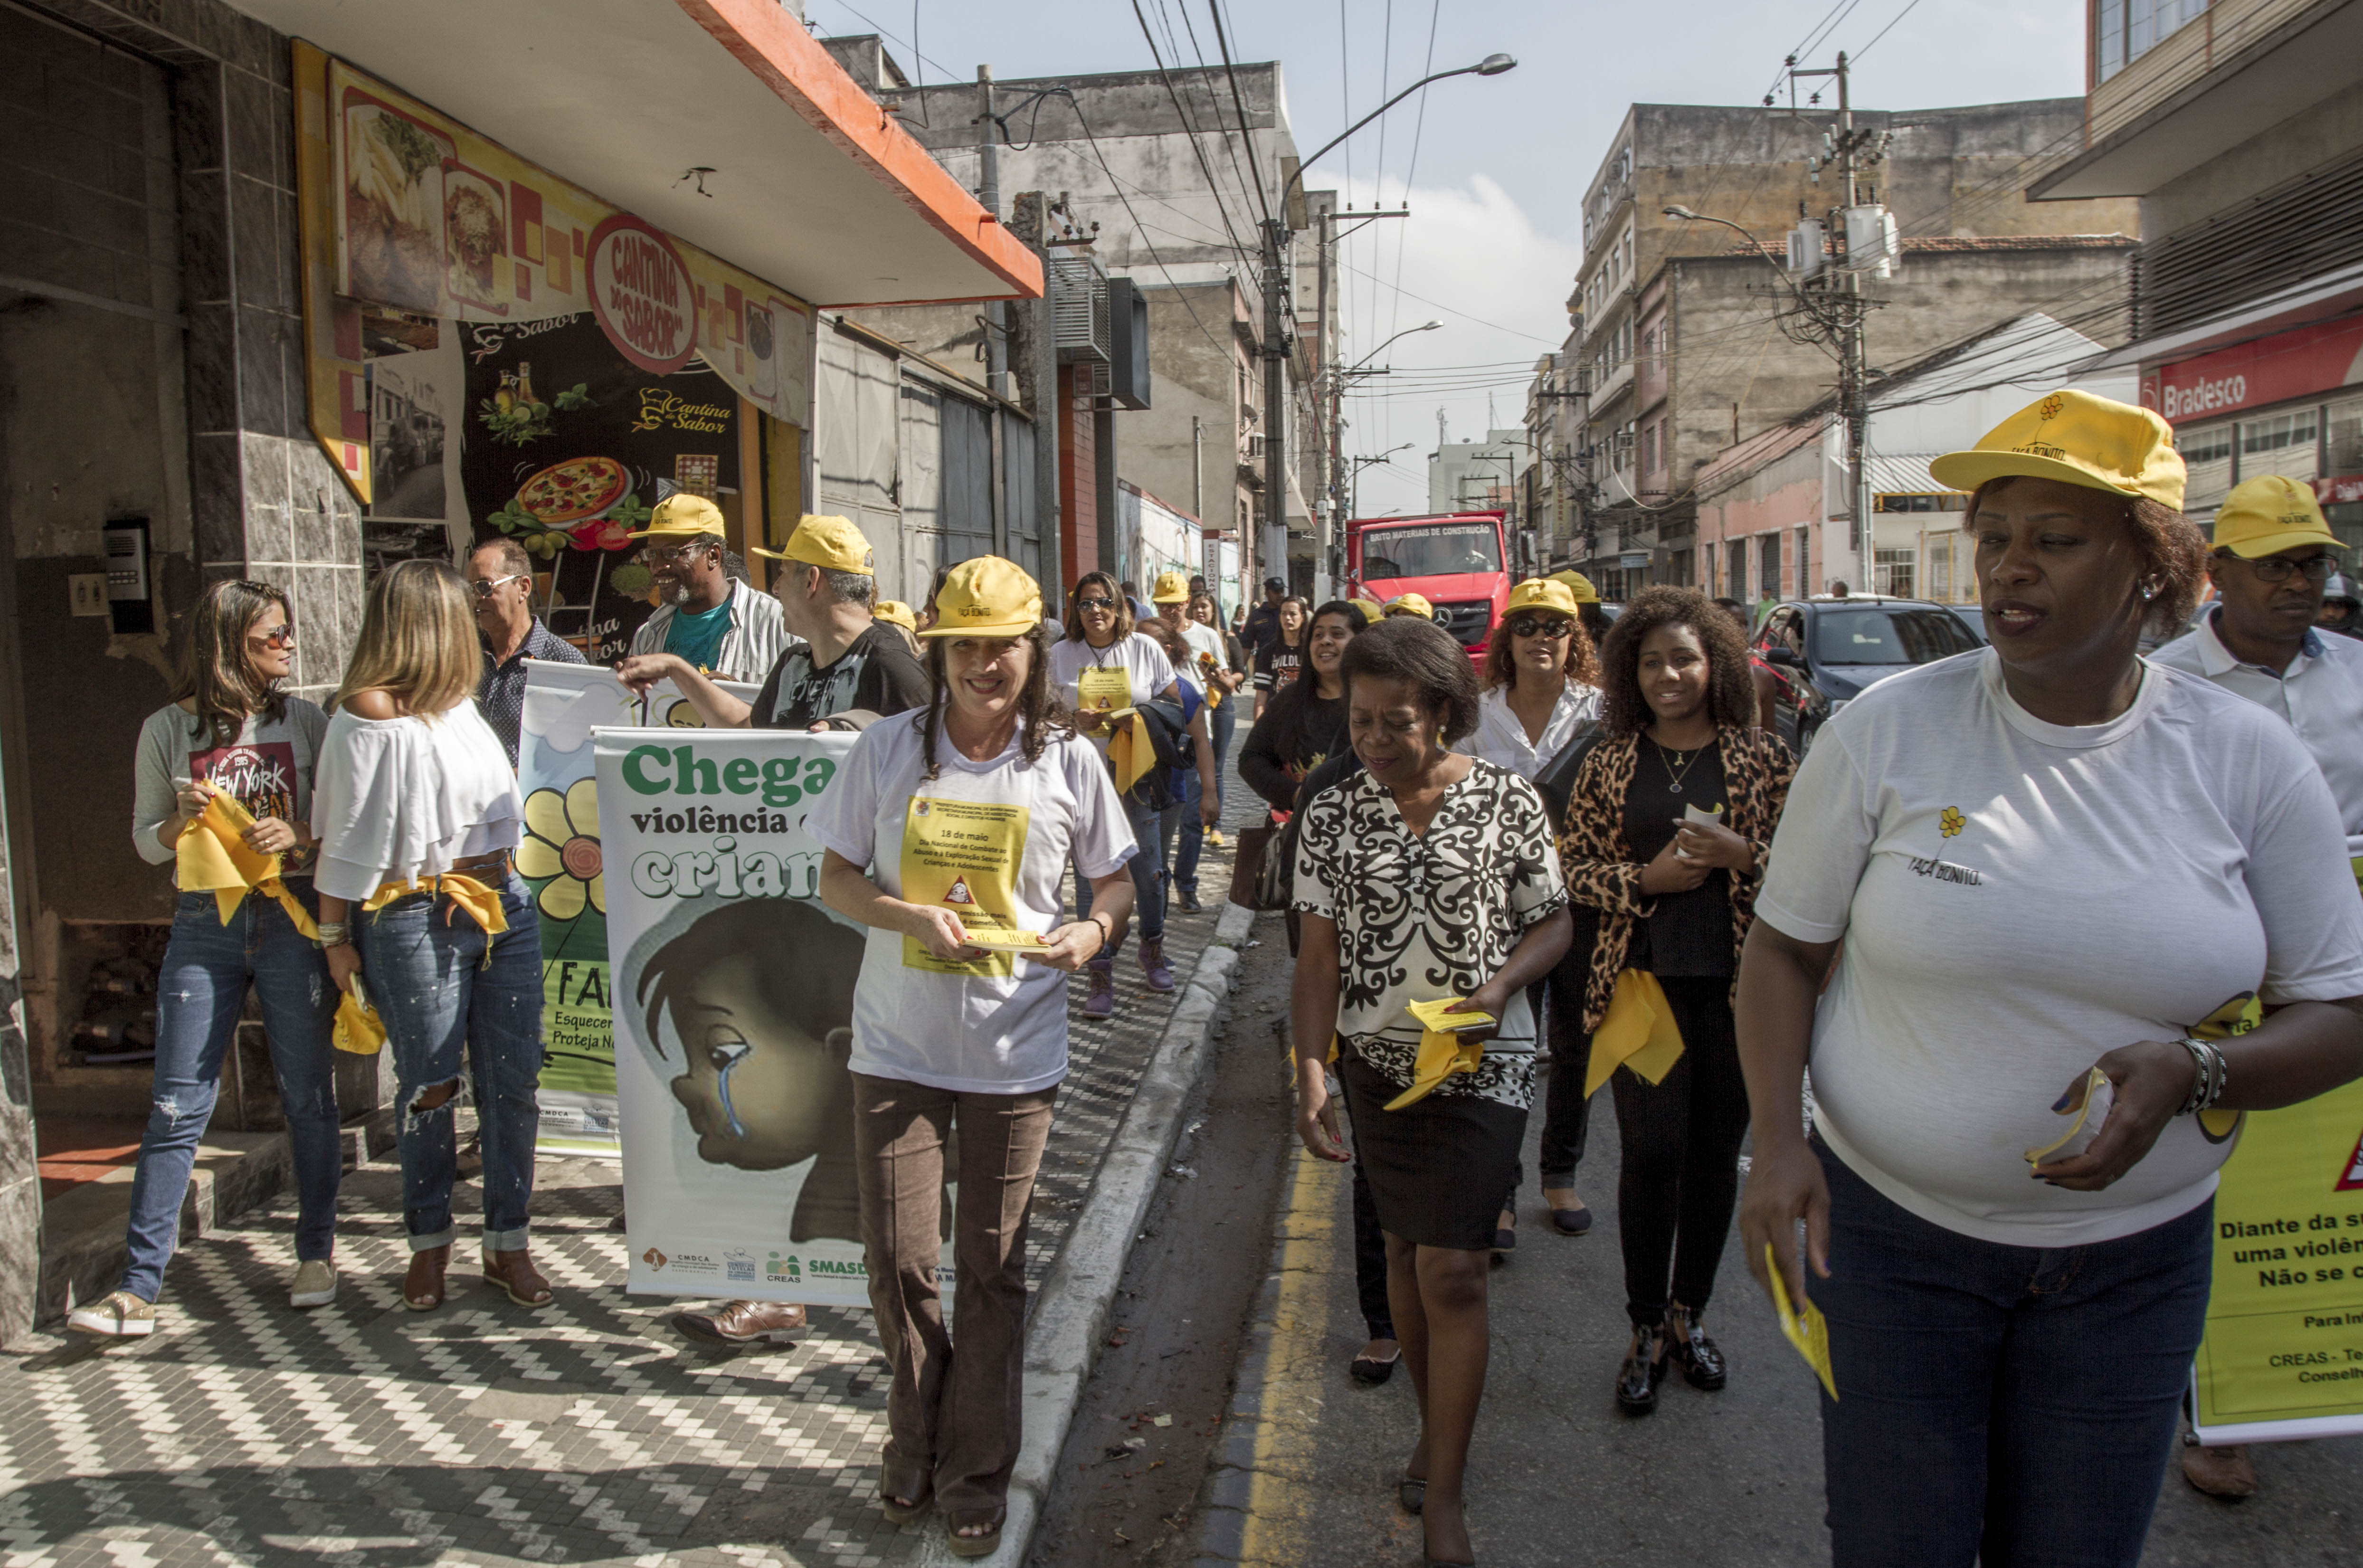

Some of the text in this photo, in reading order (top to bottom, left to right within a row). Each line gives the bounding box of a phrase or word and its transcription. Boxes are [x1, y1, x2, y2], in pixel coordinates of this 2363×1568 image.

[612, 236, 678, 309] CANTINA
[516, 312, 579, 339] Sabor
[2164, 375, 2246, 418] Bradesco
[666, 398, 731, 418] Cantina
[673, 413, 726, 433] Sabor
[1370, 532, 1391, 542] BRITO
[1392, 528, 1430, 539] MATERIAIS
[1431, 527, 1441, 536] DE
[243, 760, 290, 799] YORK
[622, 744, 836, 807] Chega
[631, 805, 788, 833] violência
[967, 833, 989, 841] maio
[945, 851, 980, 861] Exploração
[969, 845, 998, 853] Combate
[923, 859, 950, 867] Crianças
[957, 863, 999, 872] Adolescentes
[558, 962, 612, 1008] FA
[555, 1011, 612, 1032] Esquecer
[553, 1030, 598, 1051] Proteja
[2220, 1218, 2300, 1238] Diante
[2308, 1214, 2337, 1231] da
[2234, 1247, 2286, 1263] uma
[767, 1275, 801, 1283] CREAS
[2259, 1268, 2307, 1287] Não
[2316, 1267, 2344, 1282] se
[2305, 1316, 2342, 1328] Para
[2270, 1352, 2327, 1367] CREAS
